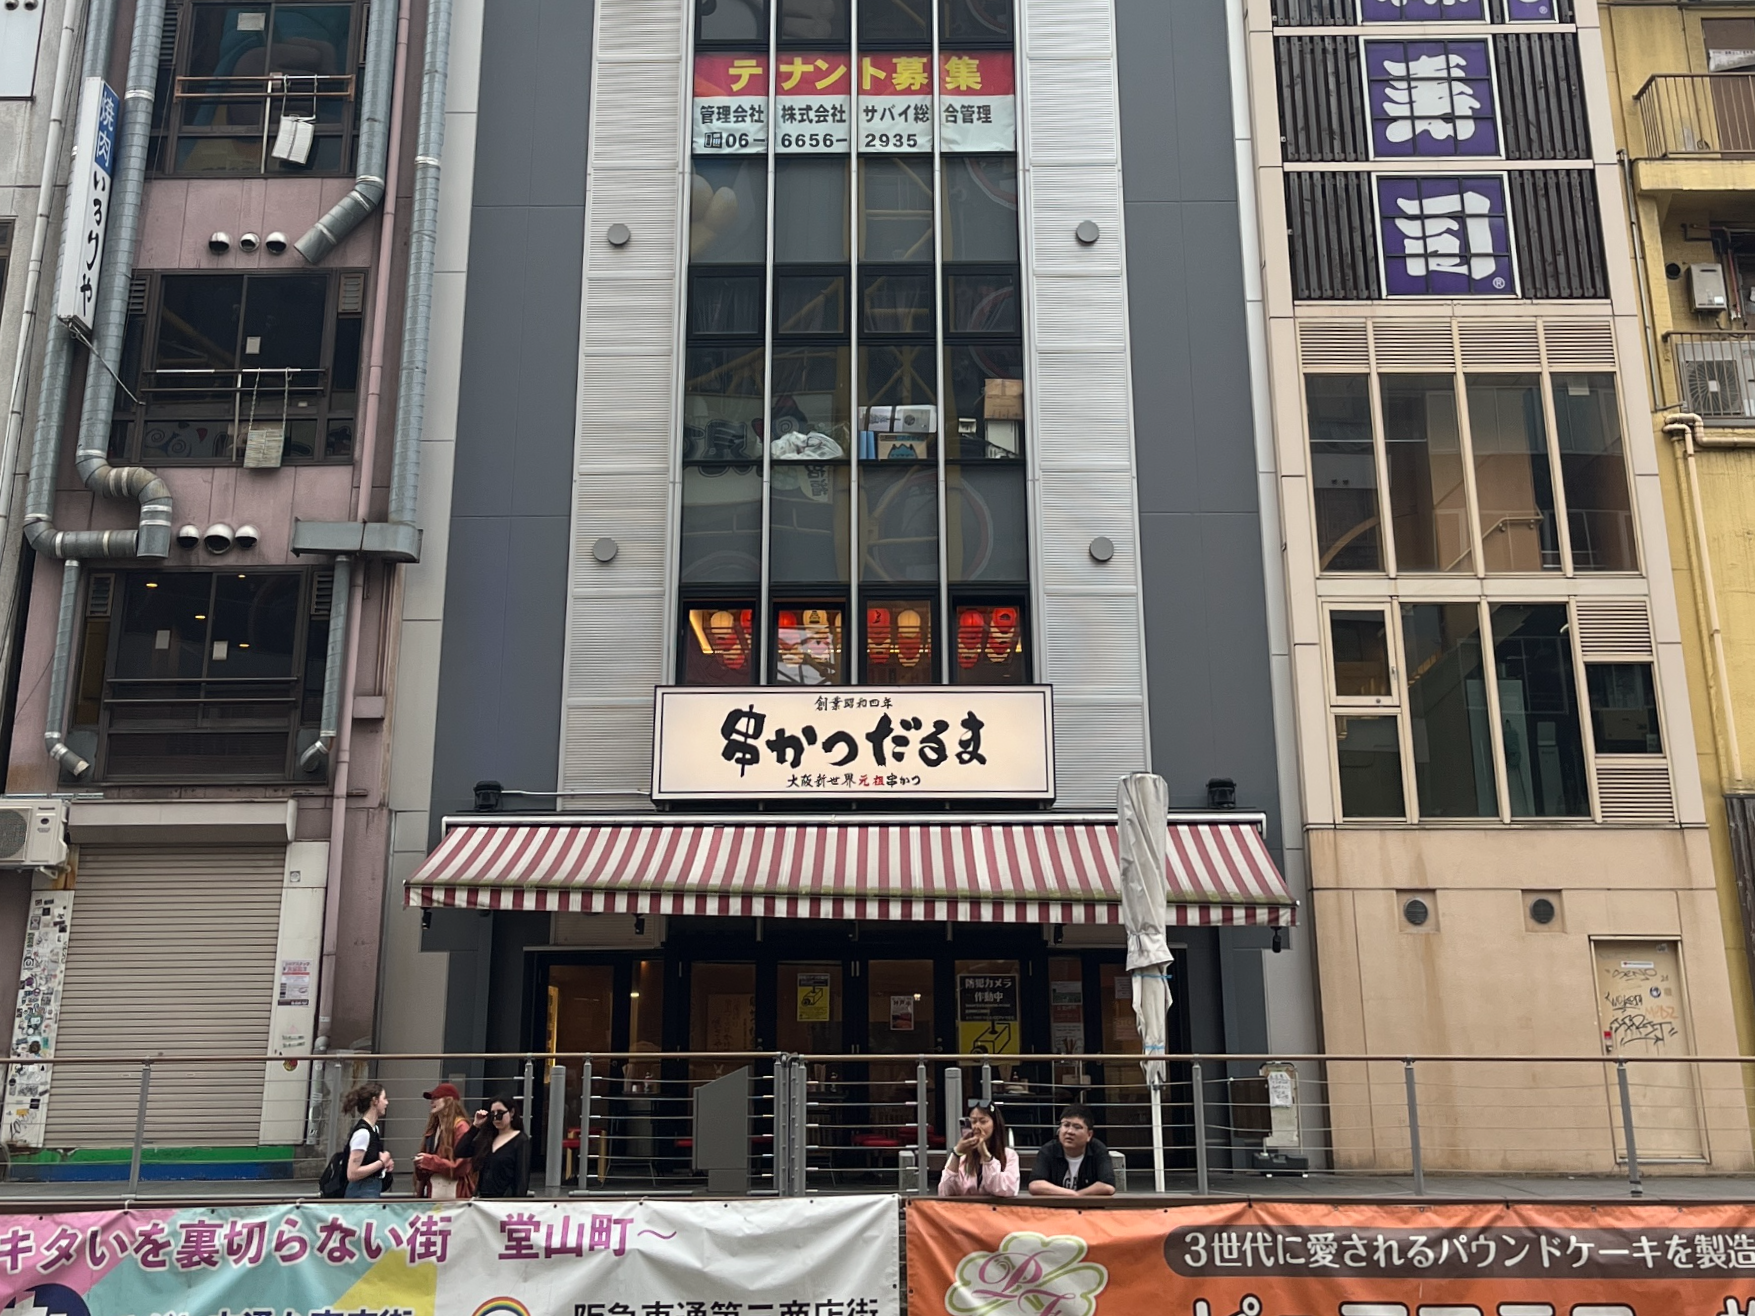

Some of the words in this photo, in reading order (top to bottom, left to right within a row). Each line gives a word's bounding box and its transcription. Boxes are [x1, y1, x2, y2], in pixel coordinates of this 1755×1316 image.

[728, 56, 983, 92] テナント募集
[814, 695, 894, 711] 創業昭和四年
[720, 704, 988, 777] 串かつだるま
